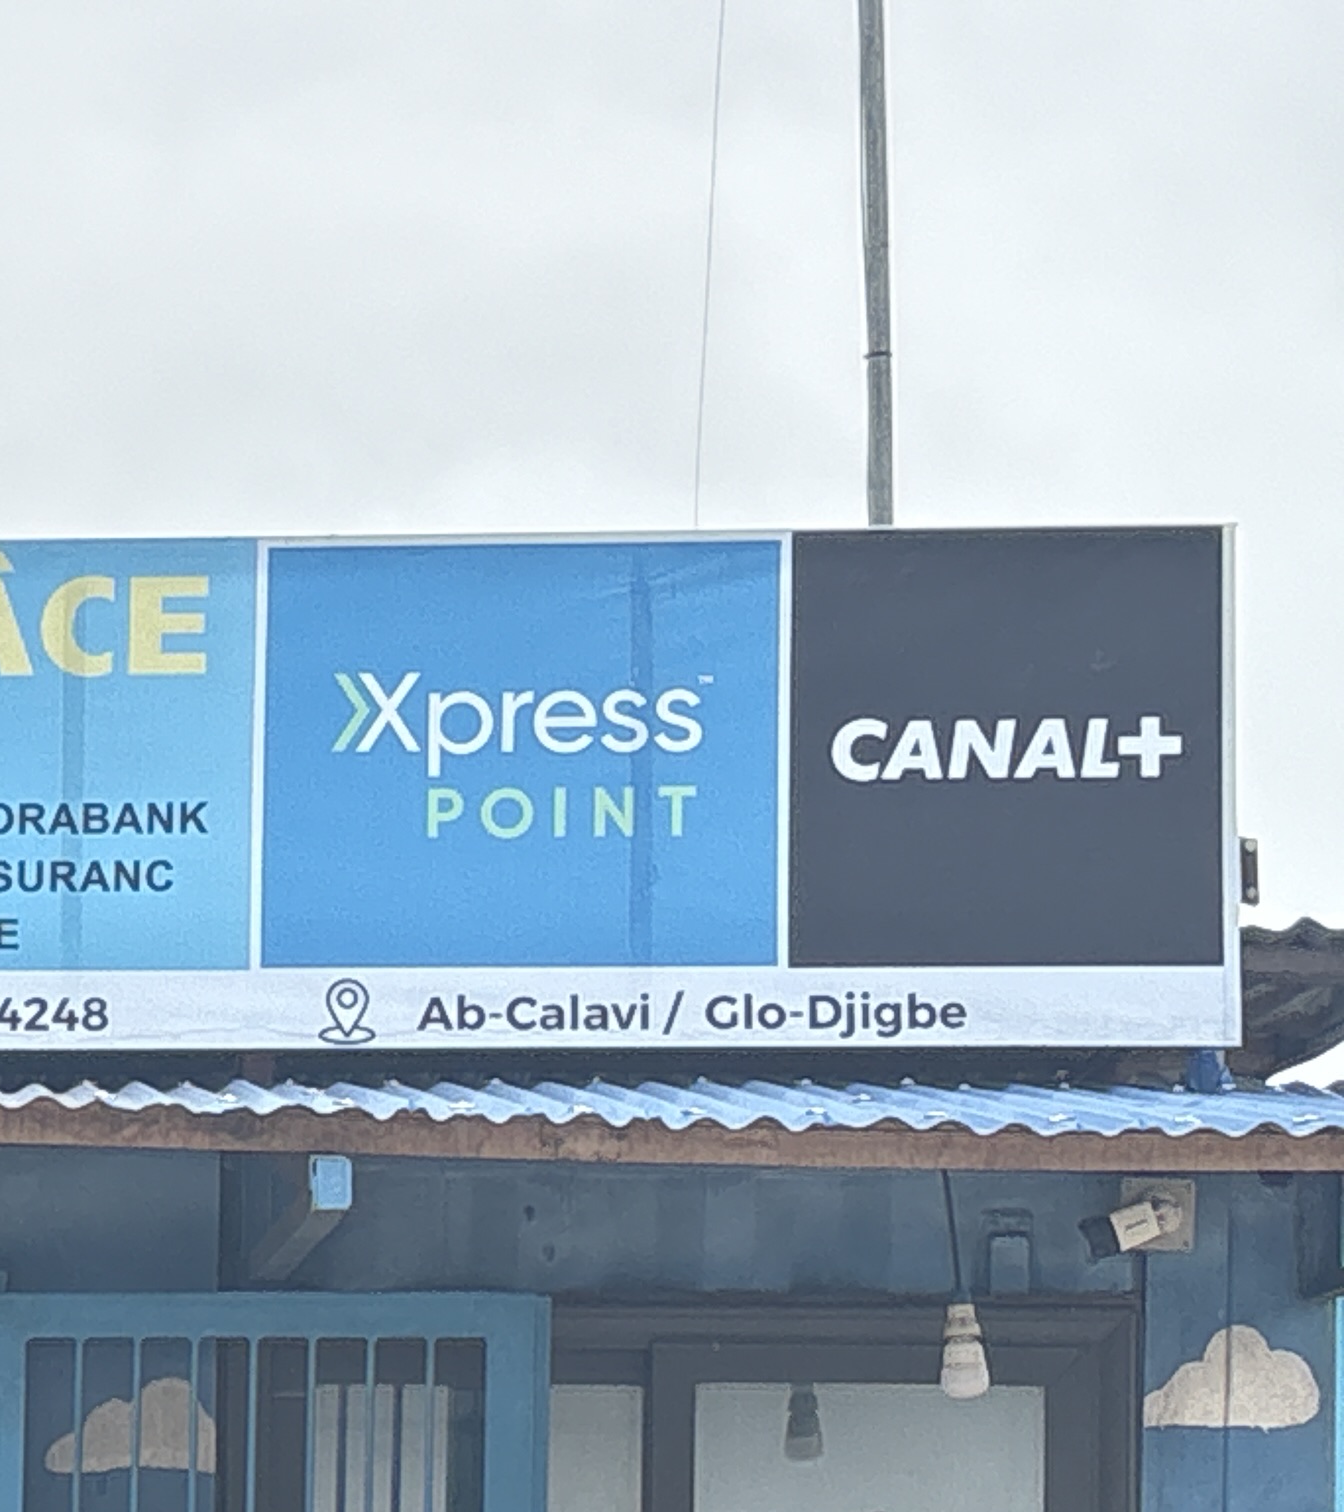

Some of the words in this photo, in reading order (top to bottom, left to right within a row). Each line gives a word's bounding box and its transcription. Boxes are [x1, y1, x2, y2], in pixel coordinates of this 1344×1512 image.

[350, 670, 703, 777] Xpress
[830, 714, 1184, 783] CANAL+
[427, 784, 698, 839] POINT
[416, 994, 652, 1034] Ab-Calavi
[704, 994, 967, 1040] Glo-Djigbe
